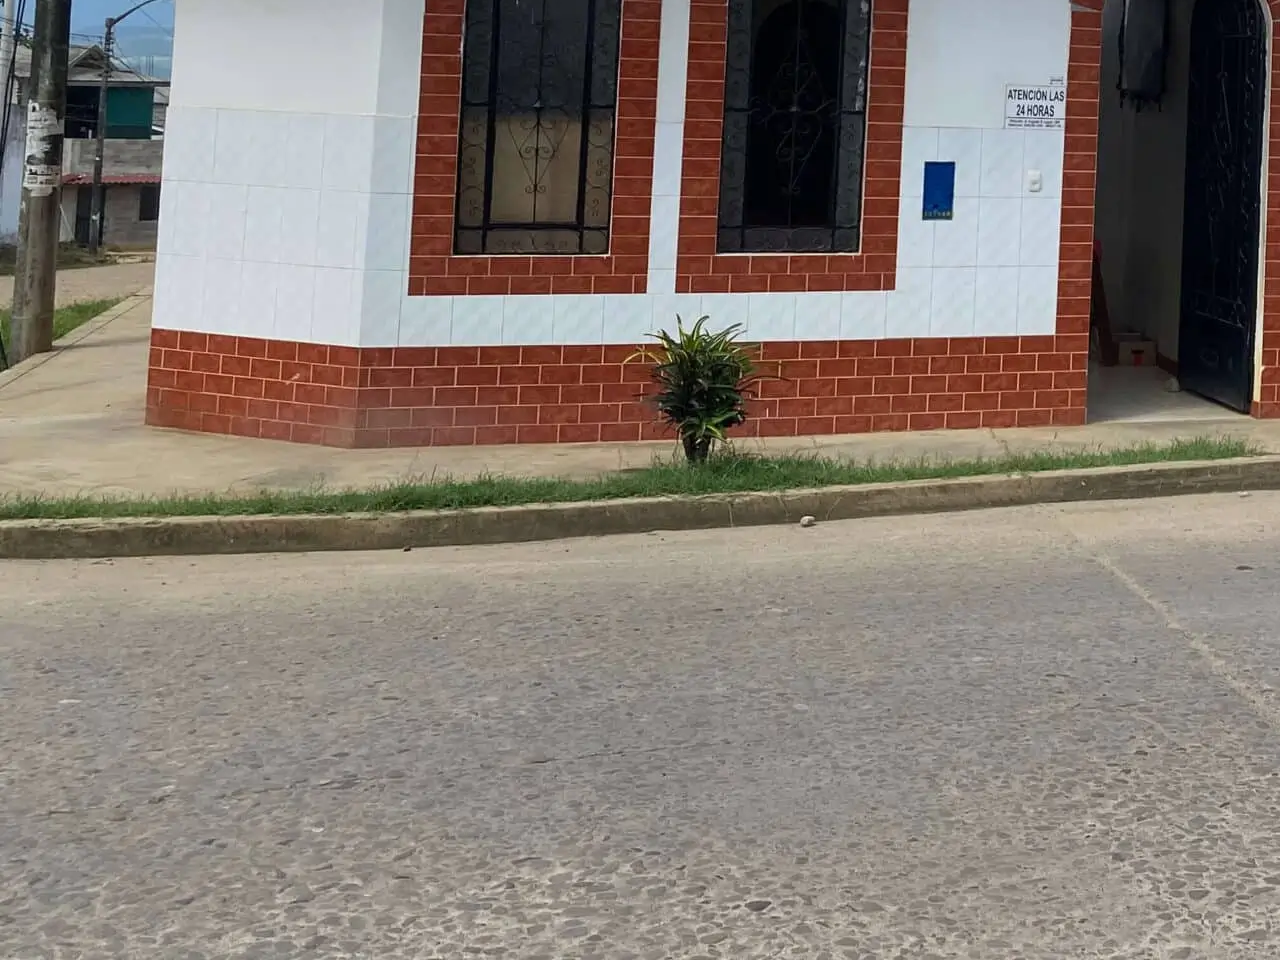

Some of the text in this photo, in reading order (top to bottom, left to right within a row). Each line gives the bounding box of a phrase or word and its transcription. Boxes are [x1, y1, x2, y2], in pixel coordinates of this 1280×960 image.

[1049, 90, 1064, 102] LAS
[1016, 104, 1055, 117] 24 HORAS
